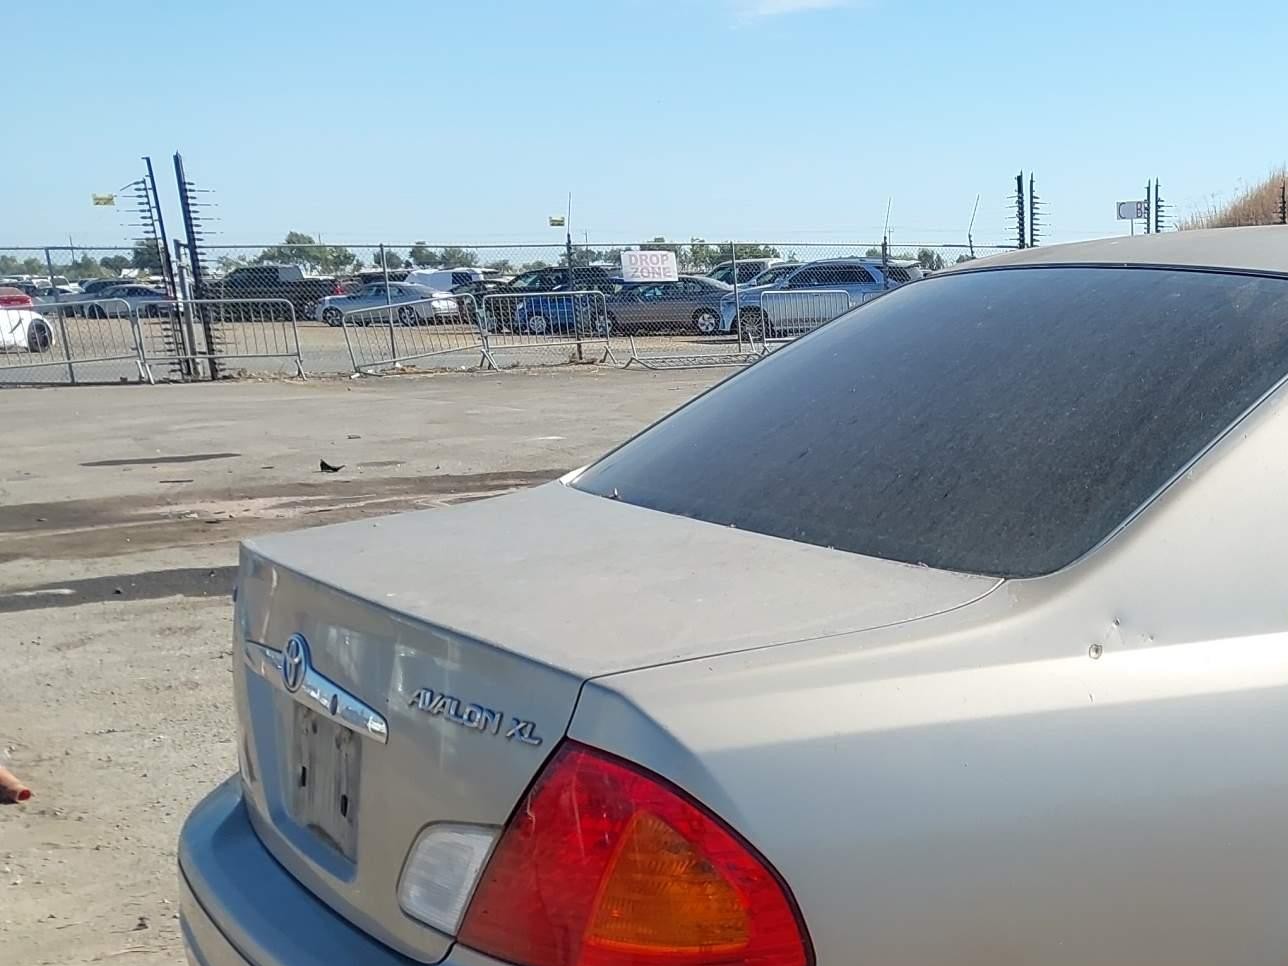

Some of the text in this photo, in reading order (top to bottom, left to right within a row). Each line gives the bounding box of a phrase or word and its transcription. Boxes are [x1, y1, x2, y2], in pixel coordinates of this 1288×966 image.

[629, 254, 669, 266] DROP
[631, 267, 673, 279] ZONE
[409, 688, 544, 746] AVALON XL
